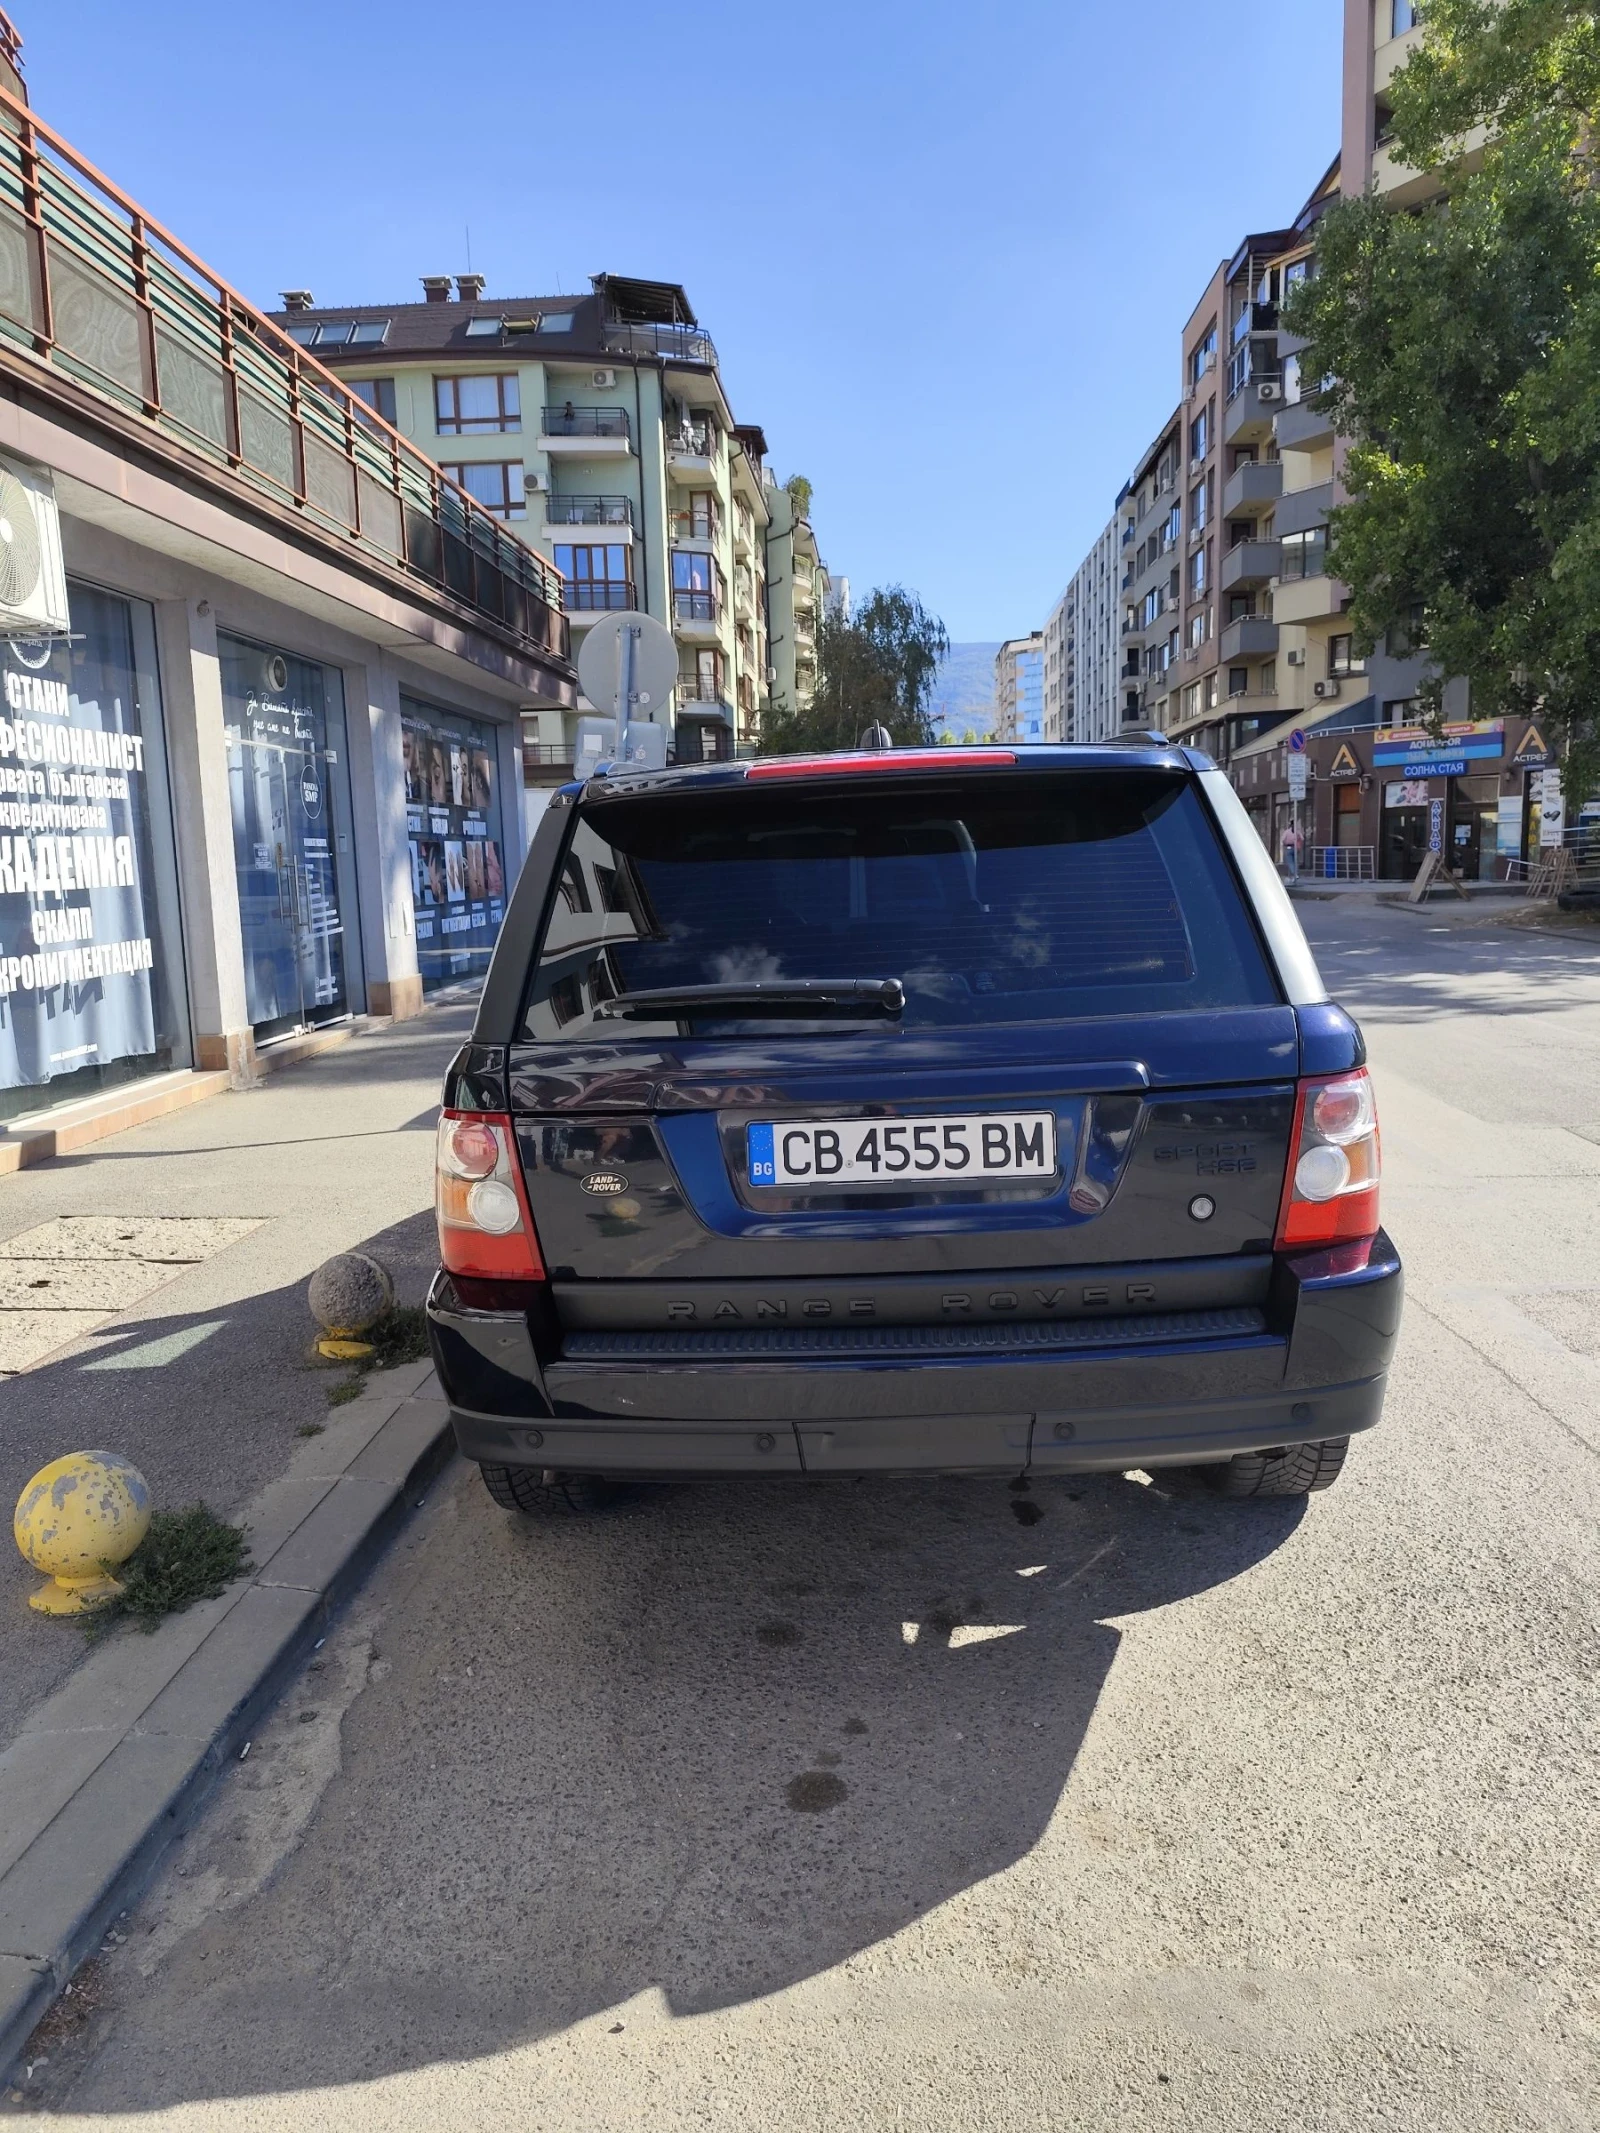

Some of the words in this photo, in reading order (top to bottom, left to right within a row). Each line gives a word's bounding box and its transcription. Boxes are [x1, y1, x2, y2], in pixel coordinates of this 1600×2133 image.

[7, 671, 70, 717] СТАНИ
[49, 767, 128, 800] българска
[1404, 764, 1437, 776] СОЛНА
[1438, 762, 1465, 774] СТАЯ
[0, 835, 135, 900] КАДЕМИЯ
[31, 907, 94, 946] СКАЛП
[782, 1129, 844, 1176] CB
[855, 1124, 971, 1173] 4555
[981, 1122, 1045, 1169] BM
[1155, 1142, 1256, 1161] SPORT
[1197, 1157, 1257, 1176] HSE
[753, 1161, 773, 1176] BG
[666, 1299, 876, 1321] RANGE
[942, 1284, 1157, 1313] ROVER
